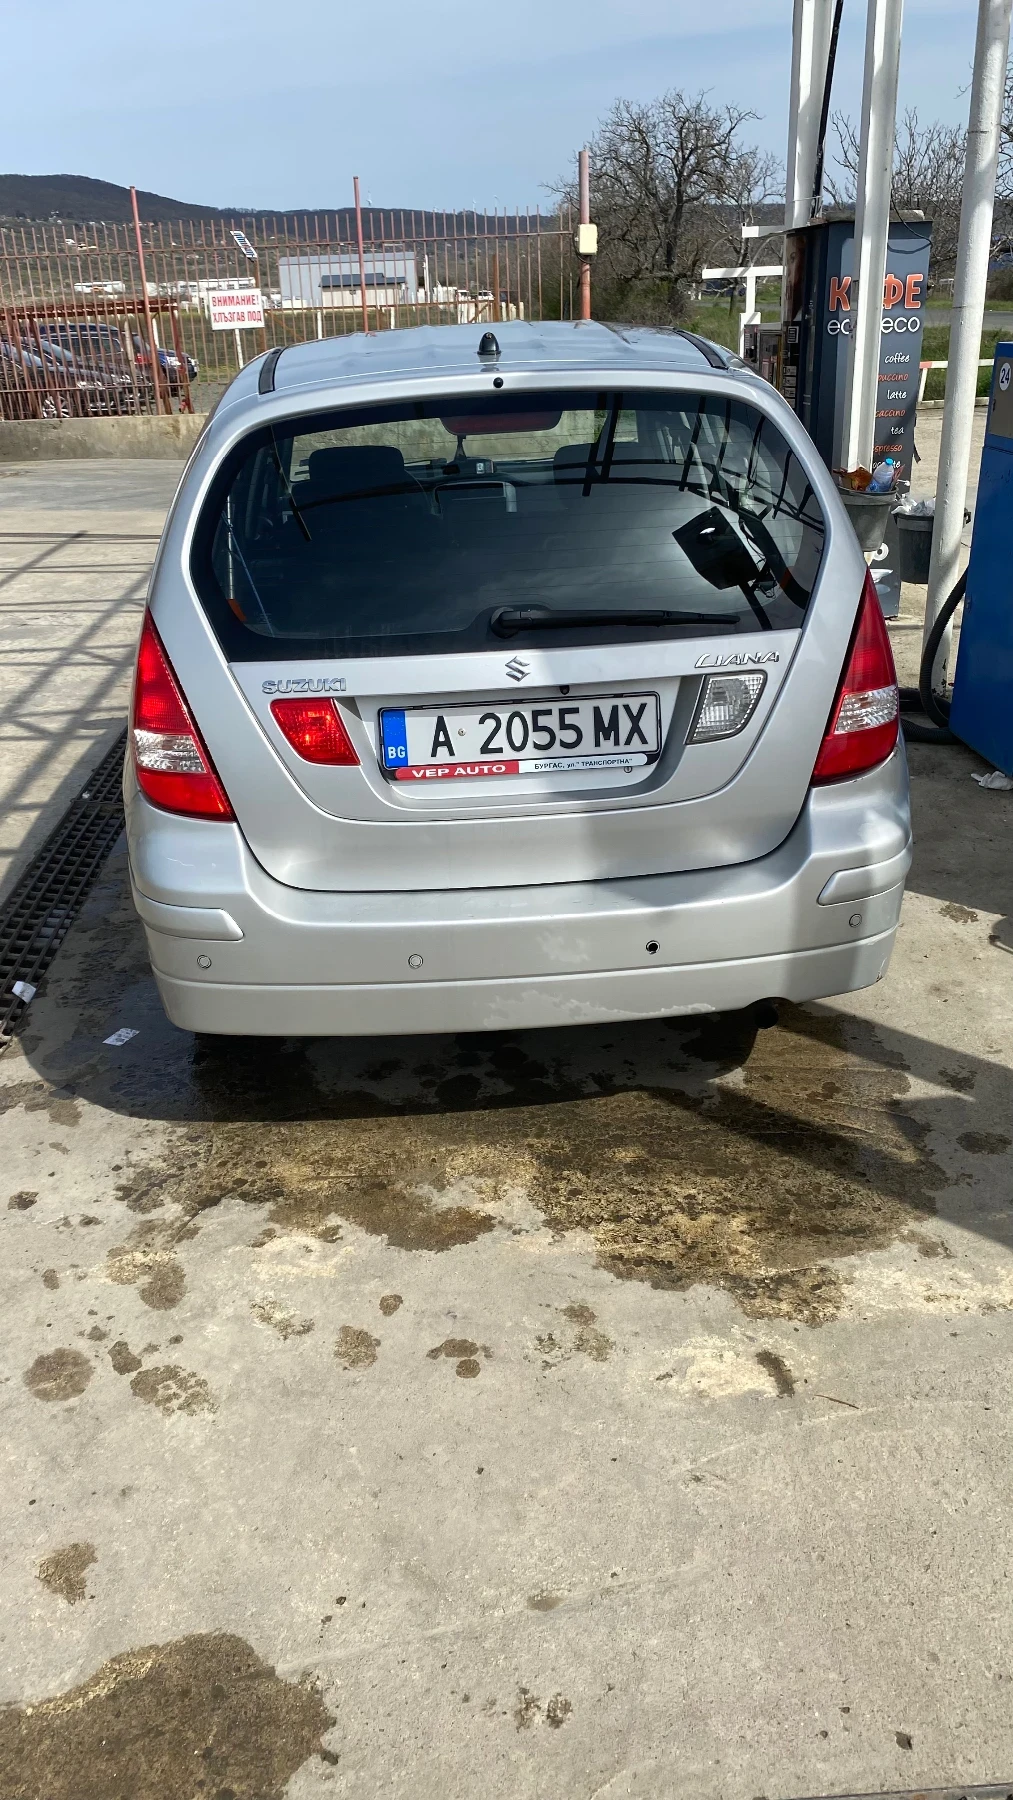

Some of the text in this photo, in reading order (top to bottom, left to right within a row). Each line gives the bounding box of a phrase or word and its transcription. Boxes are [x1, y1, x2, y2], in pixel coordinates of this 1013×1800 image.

[829, 273, 924, 312] КФЕ
[211, 295, 260, 307] ВНИМАНИЕ!
[247, 310, 263, 323] ПОД
[827, 316, 920, 335] ec eco
[884, 352, 910, 364] coffee
[1000, 367, 1010, 384] 24
[887, 389, 907, 400] latte
[890, 426, 904, 435] tea
[873, 444, 903, 455] spresso
[694, 651, 780, 669] LIANA
[262, 678, 347, 694] SUZUKI
[478, 706, 584, 755] 2055
[593, 702, 649, 748] MX
[388, 746, 406, 759] BG
[412, 764, 506, 778] VEP AUTO
[534, 762, 566, 770] БУРГАС,
